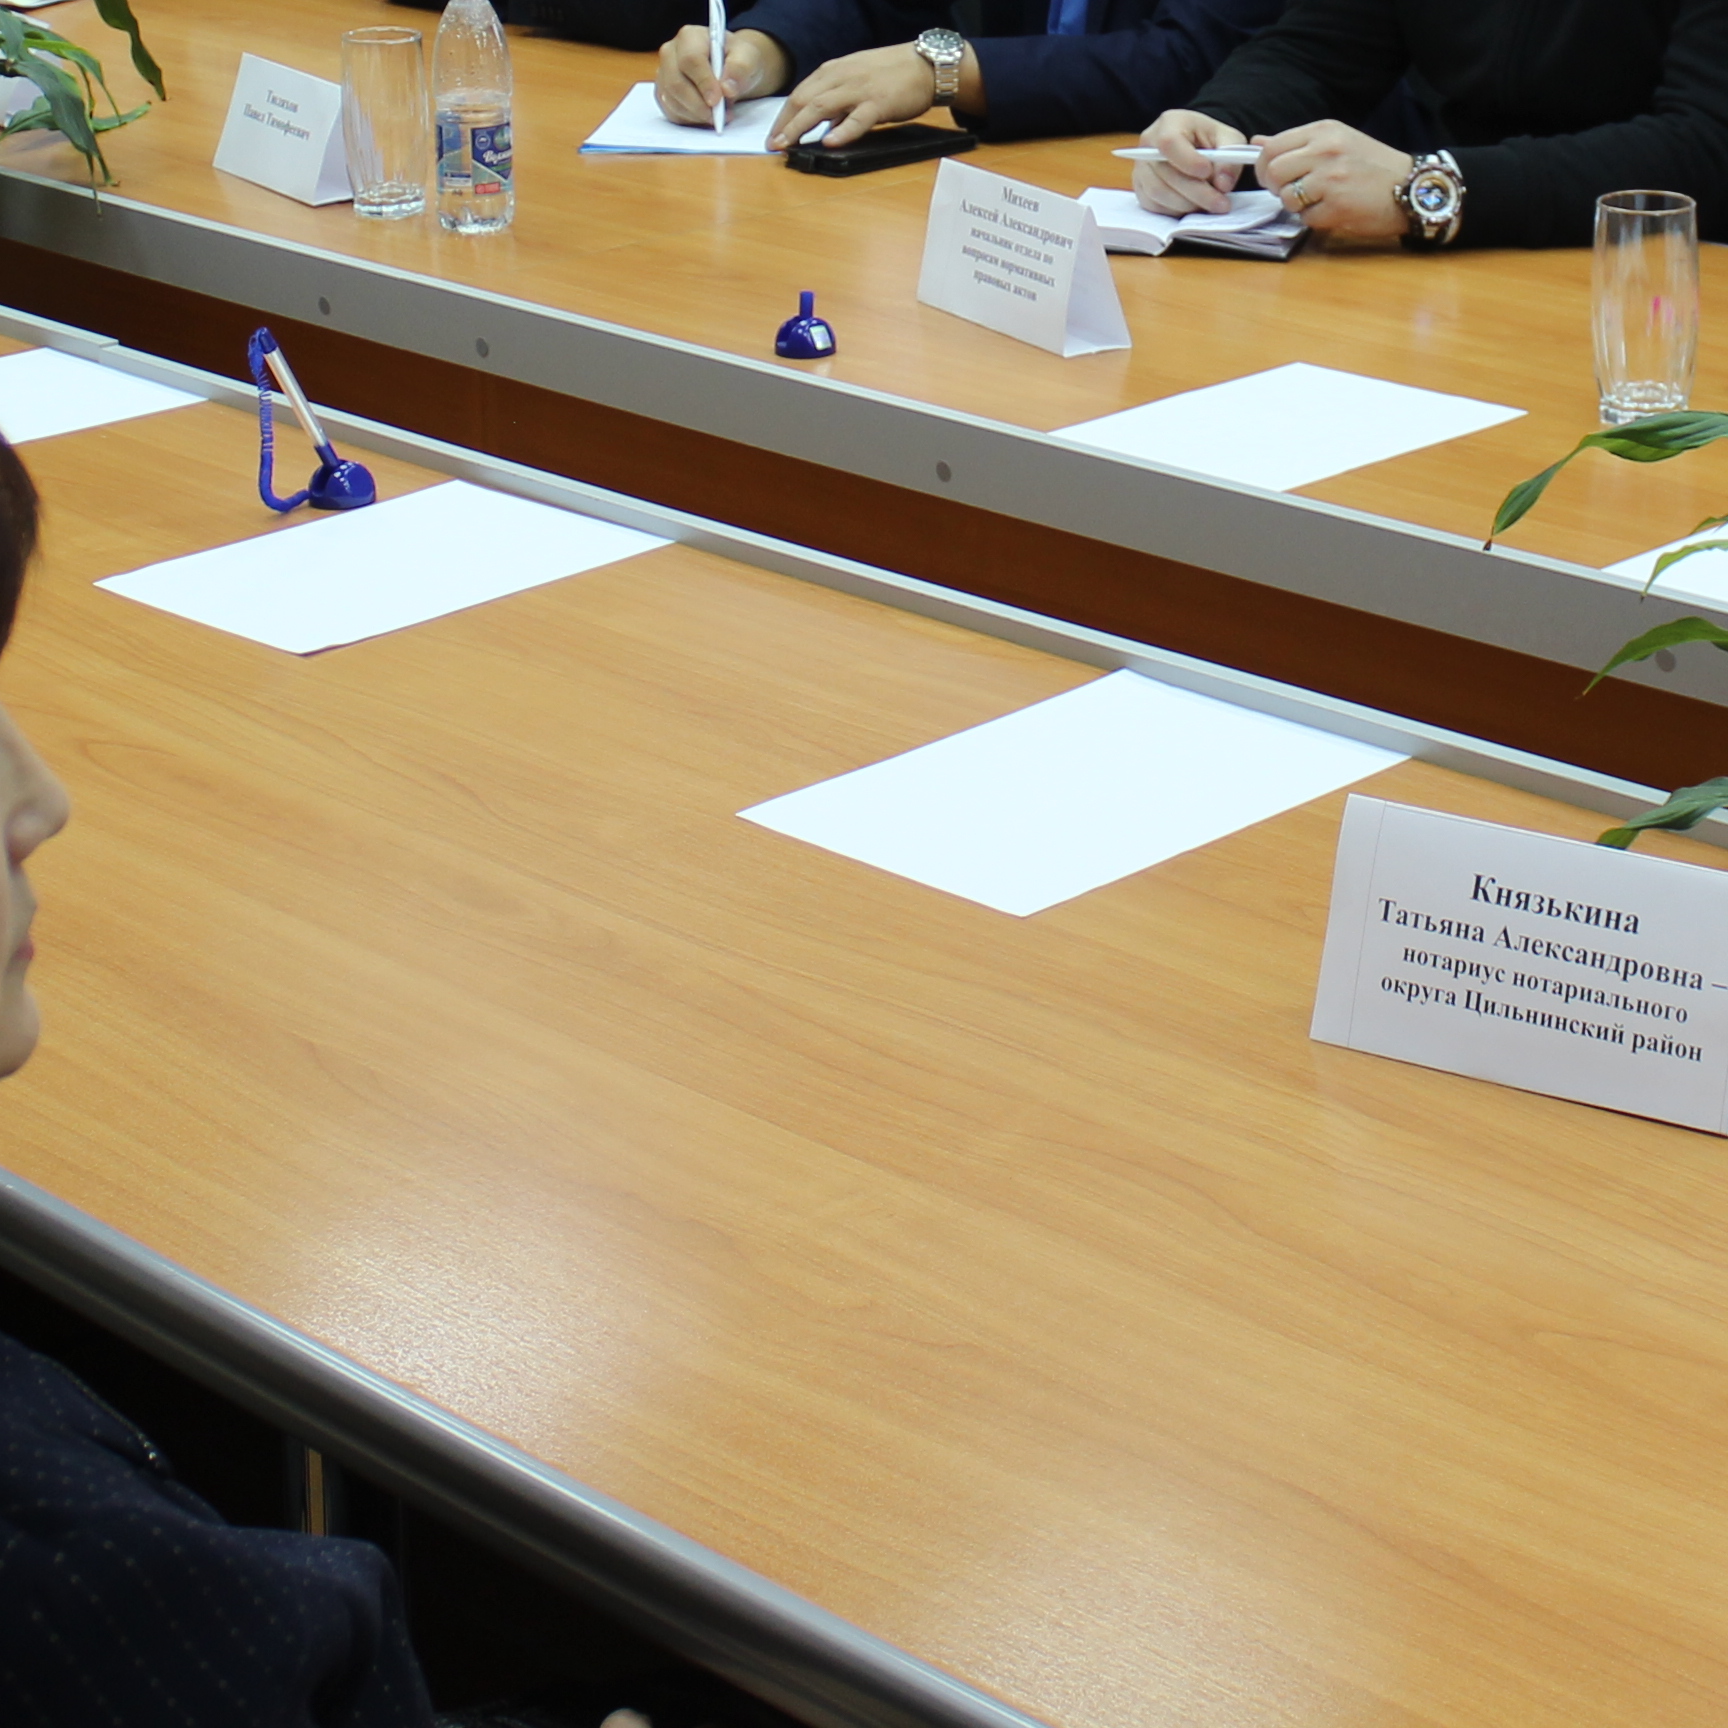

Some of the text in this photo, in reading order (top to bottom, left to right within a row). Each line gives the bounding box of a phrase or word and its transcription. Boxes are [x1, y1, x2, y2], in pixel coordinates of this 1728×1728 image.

[959, 199, 1074, 249] Алексей Александрович
[1001, 186, 1040, 212] Михеев
[962, 245, 1056, 288] вопросам нормативных
[970, 227, 1014, 250] начальник
[1014, 244, 1041, 261] отдела
[973, 270, 1037, 301] правовых актов
[1469, 873, 1640, 935] Князькина
[1379, 898, 1485, 944] Татьяна
[1493, 926, 1703, 991] Александровна
[1402, 946, 1688, 1024] нотариус нотариального
[1381, 975, 1703, 1062] округа Цильнинский район
